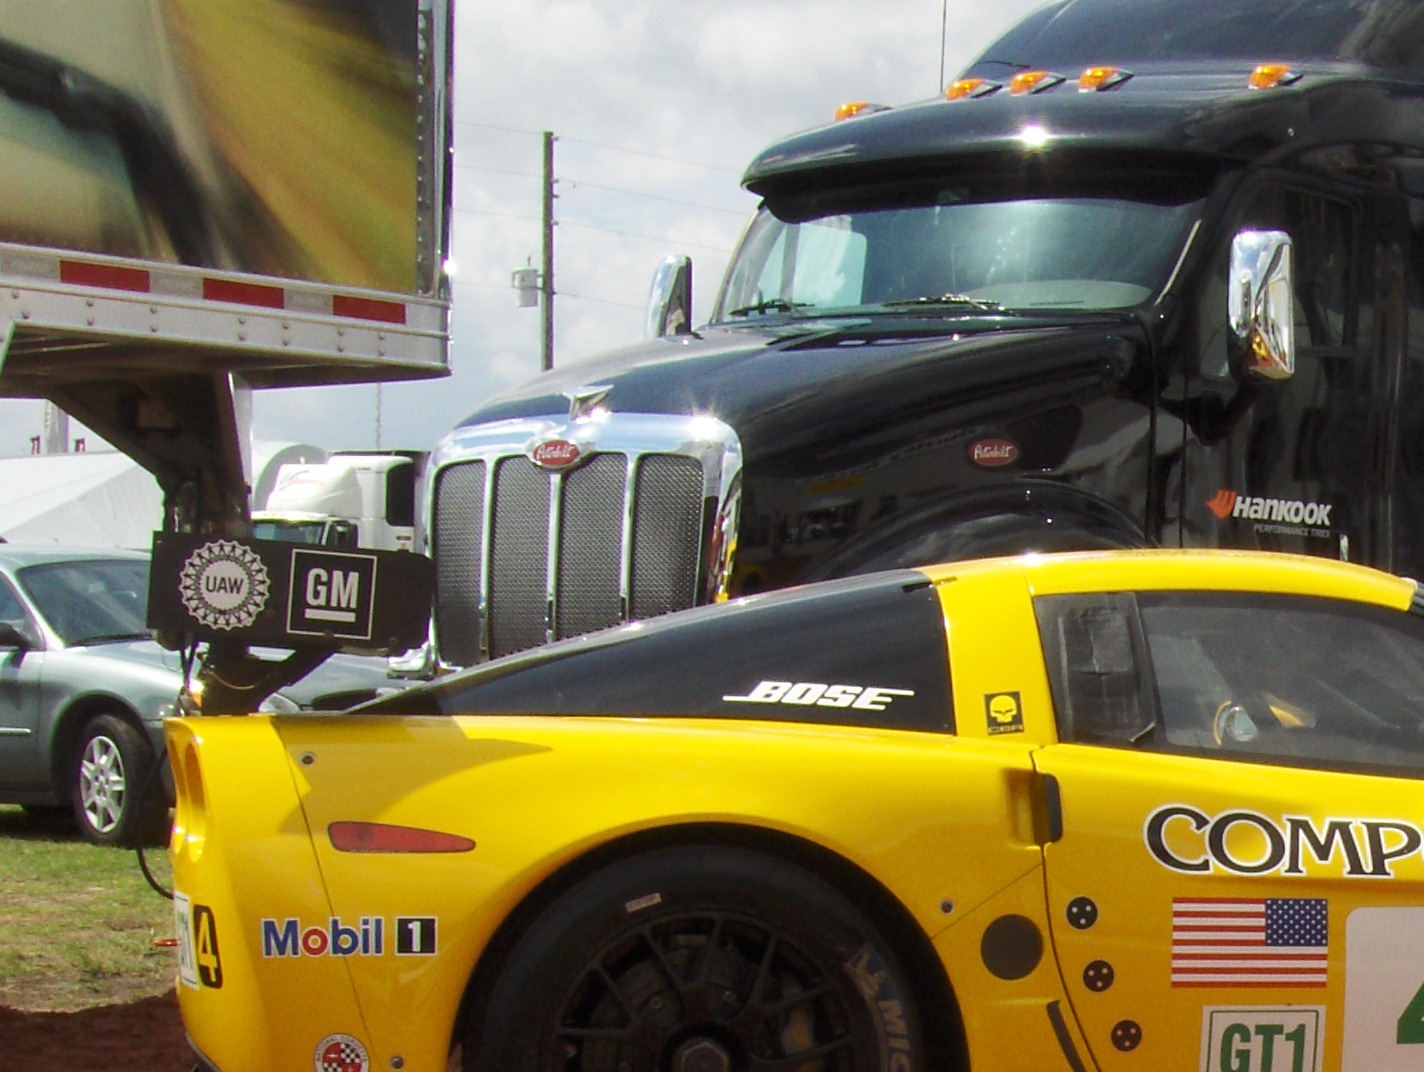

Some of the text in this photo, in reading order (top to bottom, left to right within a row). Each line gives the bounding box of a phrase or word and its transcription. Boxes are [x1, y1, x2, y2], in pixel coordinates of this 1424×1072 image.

[204, 575, 244, 595] UAW
[306, 566, 360, 610] GM
[722, 680, 915, 711] BOSE
[195, 907, 221, 985] 4
[262, 917, 383, 957] Mobil
